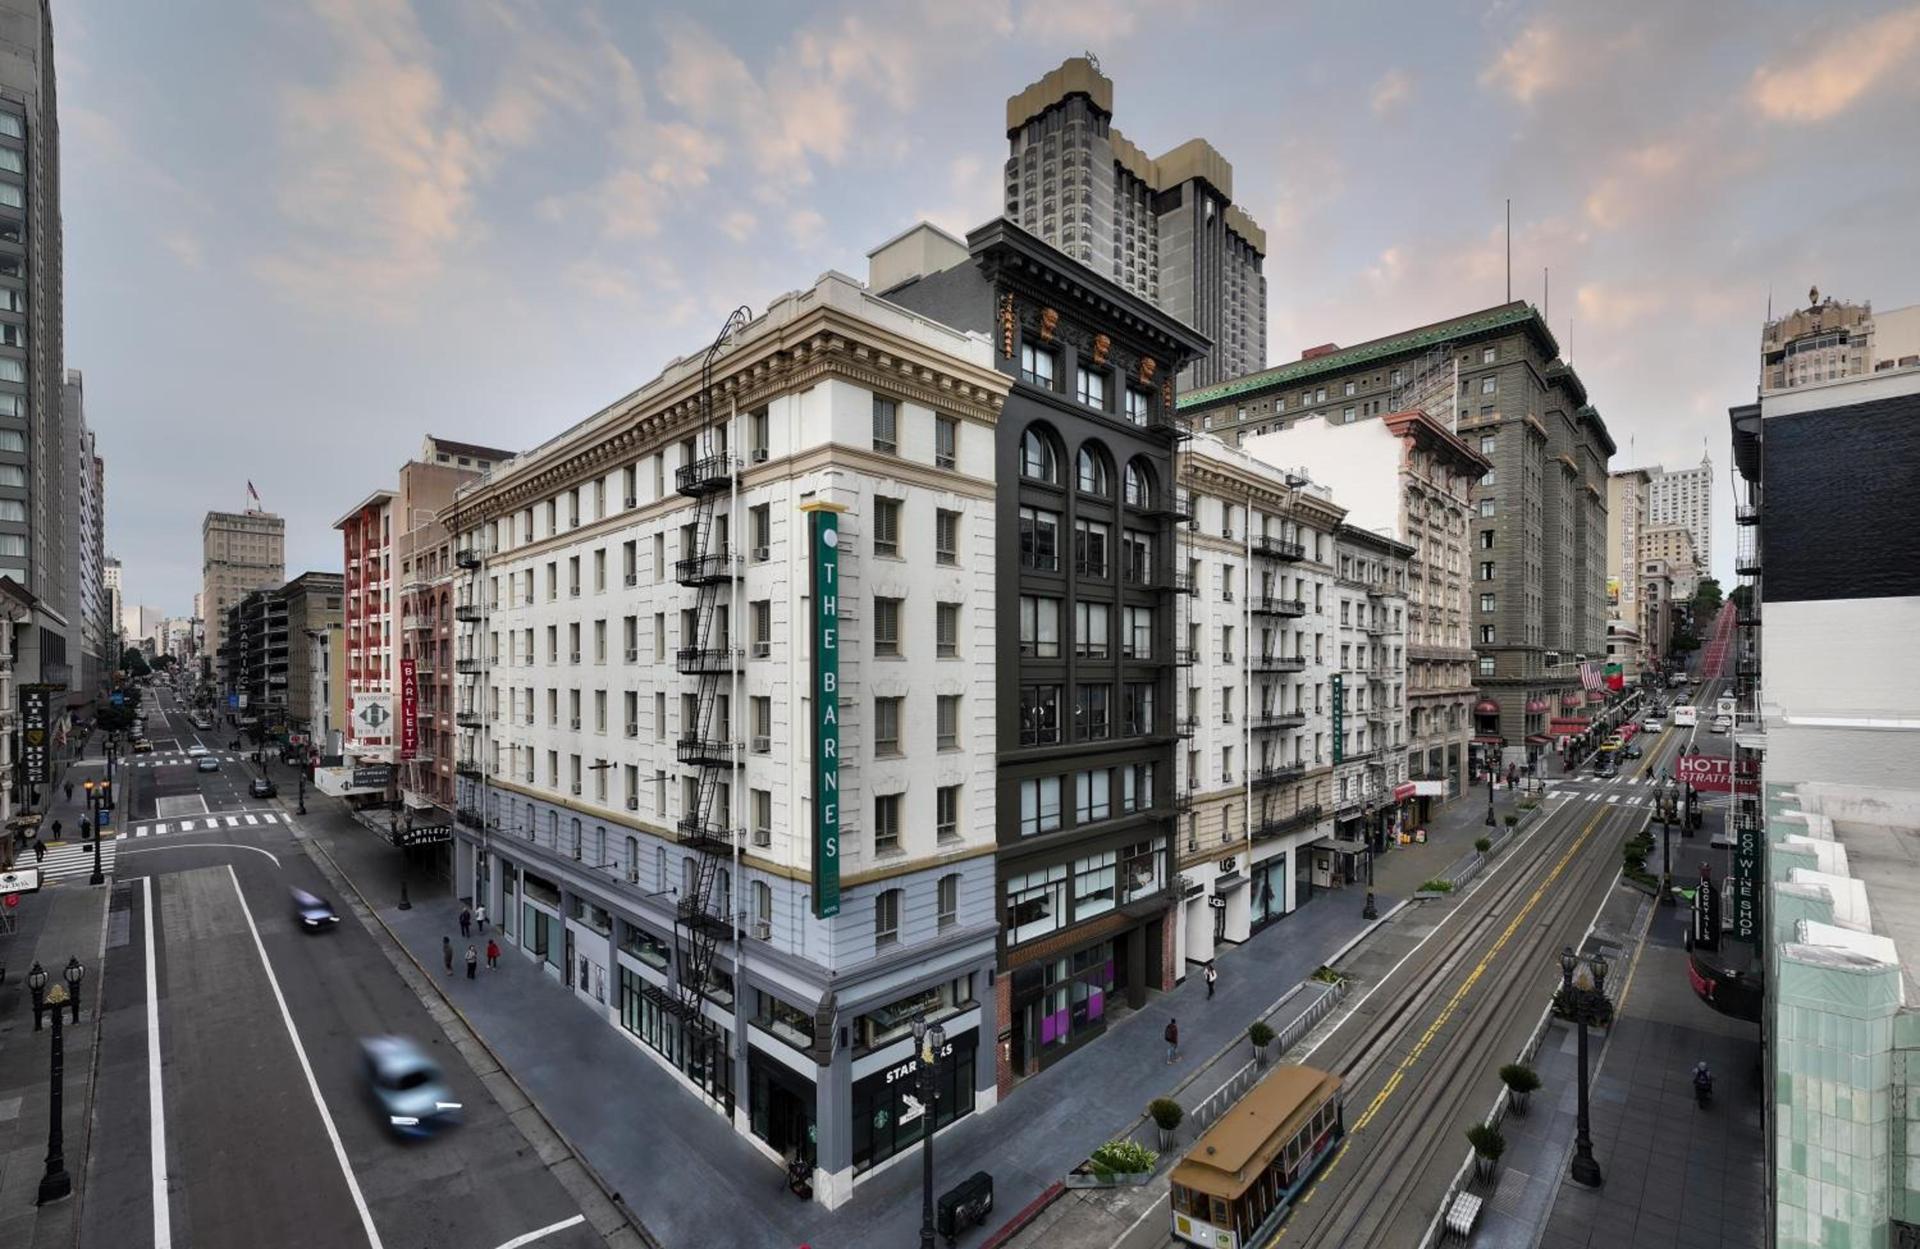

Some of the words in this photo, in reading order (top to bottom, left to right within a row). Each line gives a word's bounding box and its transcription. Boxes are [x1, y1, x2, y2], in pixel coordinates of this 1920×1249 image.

[823, 563, 837, 650] THE
[240, 624, 249, 684] PARKING
[404, 667, 414, 747] BARTLETT
[823, 672, 838, 857] BARNES
[1680, 758, 1748, 774] HOTEL
[1740, 859, 1754, 897] WINE
[1740, 901, 1753, 936] SHOP
